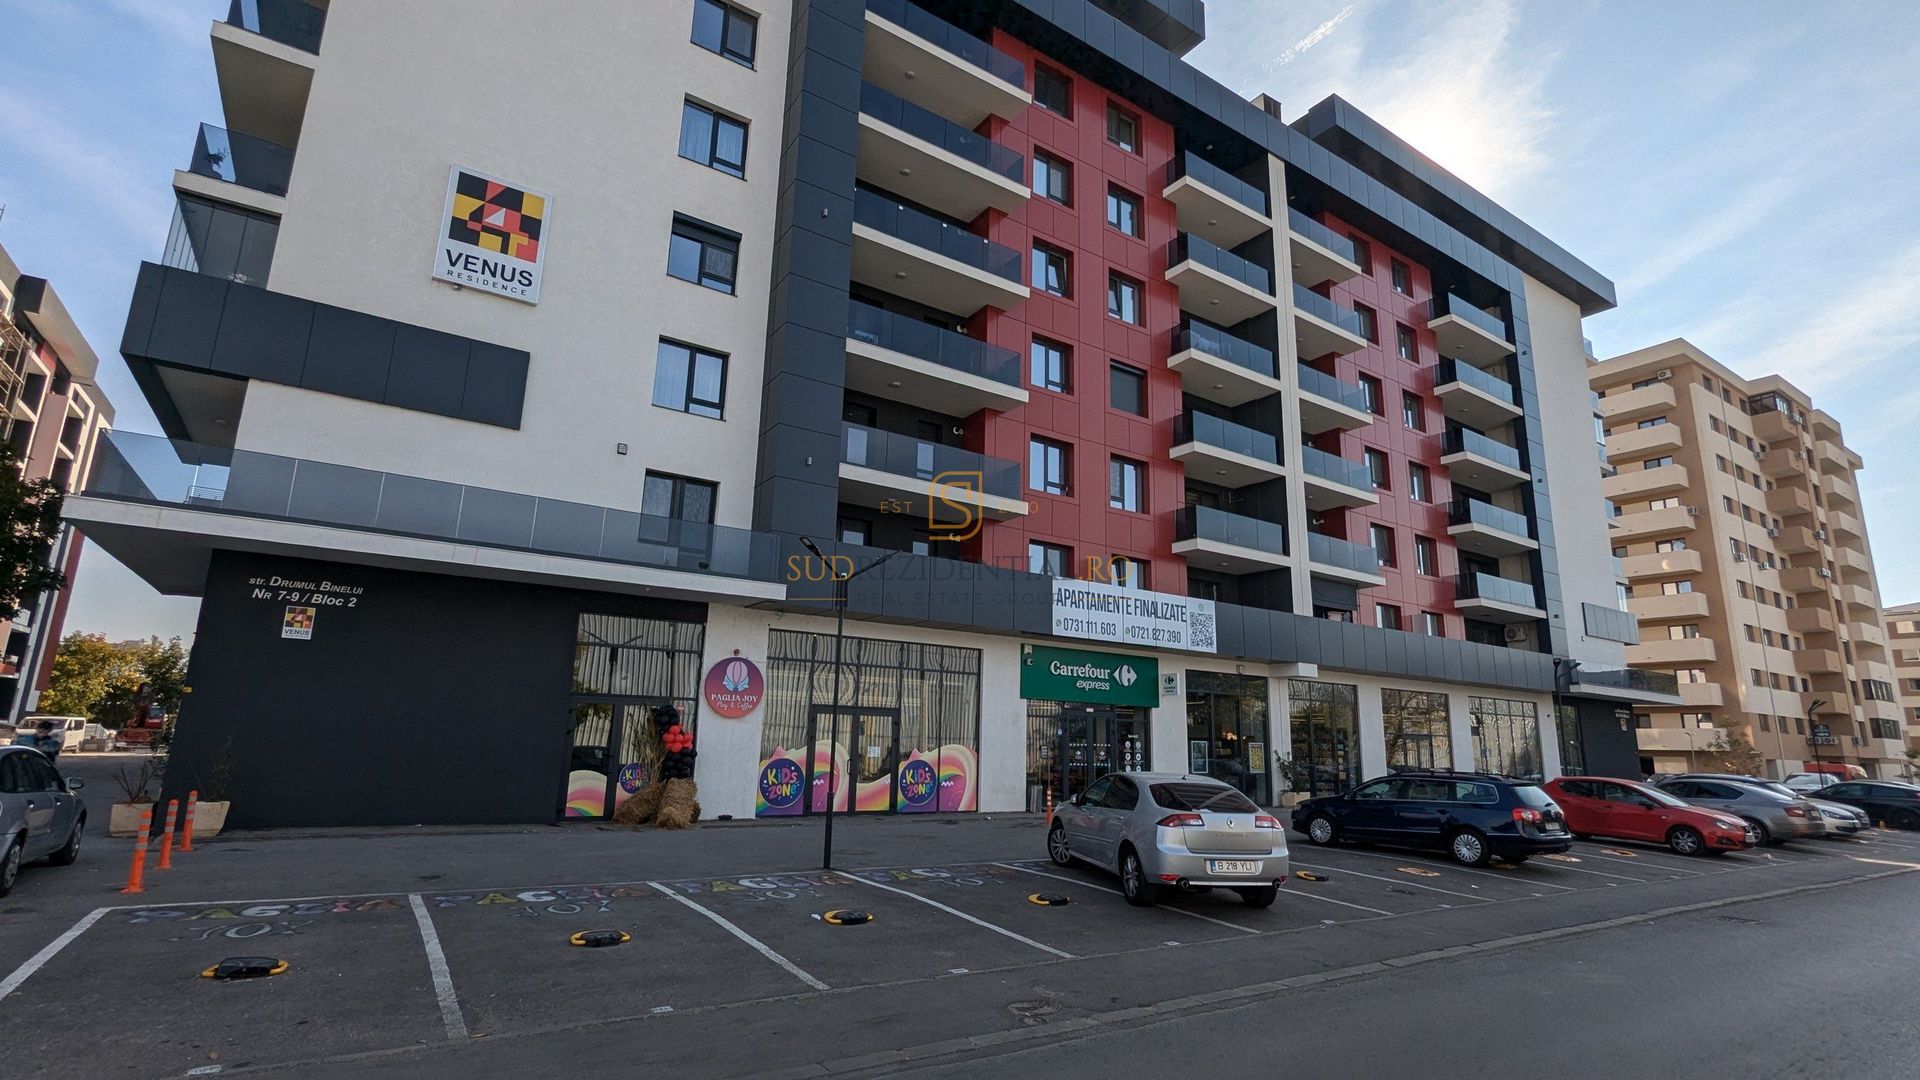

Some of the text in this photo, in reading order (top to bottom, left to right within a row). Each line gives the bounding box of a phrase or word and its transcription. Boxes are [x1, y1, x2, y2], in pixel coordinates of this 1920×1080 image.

[446, 248, 533, 288] VENUS
[447, 269, 527, 296] RESIDENCE
[277, 590, 300, 603] 7-9
[311, 593, 344, 606] Bloc
[347, 597, 357, 607] 2
[1055, 587, 1187, 623] APARTAMENTE FINALIZATE
[1050, 660, 1111, 680] Carrefour
[1076, 679, 1110, 692] express
[1217, 861, 1223, 870] B
[1226, 861, 1238, 871] 218
